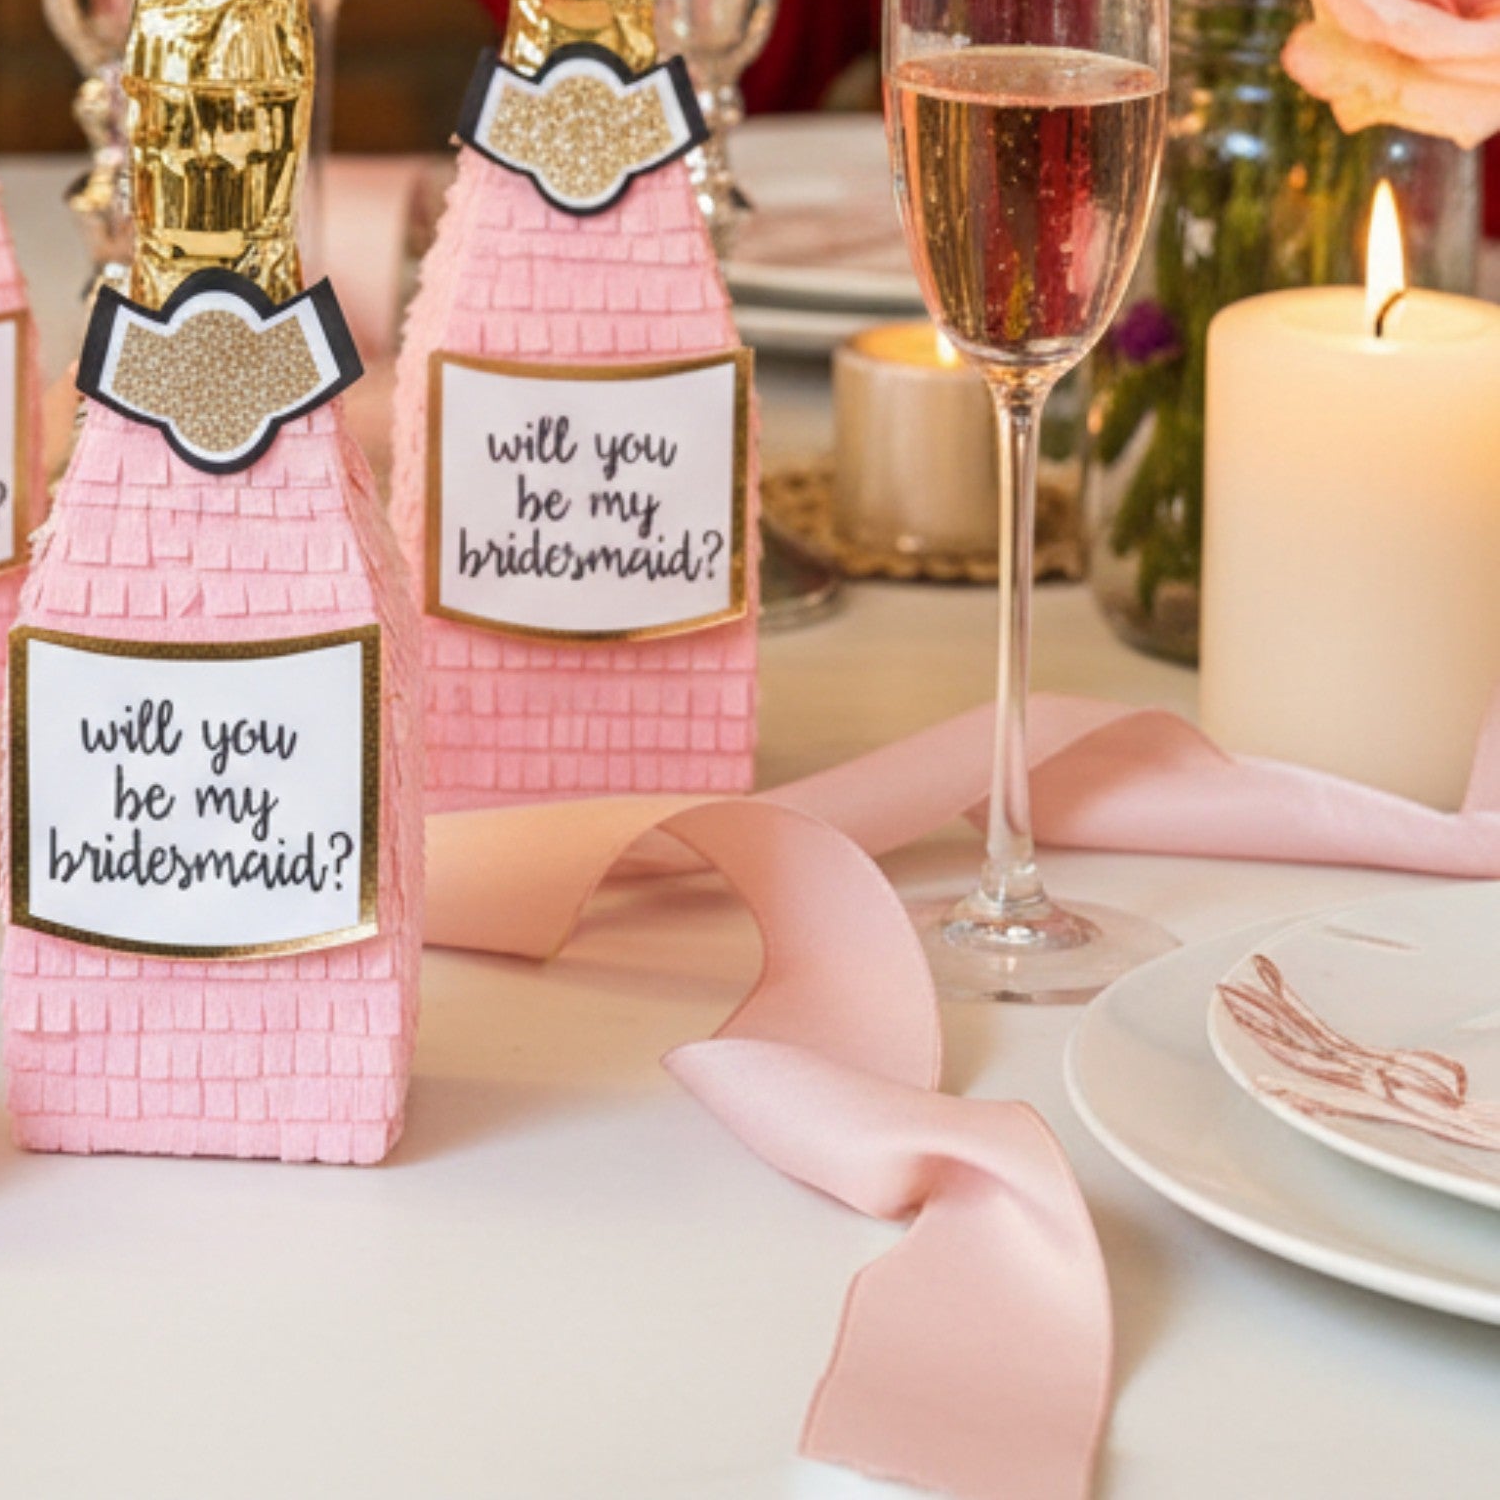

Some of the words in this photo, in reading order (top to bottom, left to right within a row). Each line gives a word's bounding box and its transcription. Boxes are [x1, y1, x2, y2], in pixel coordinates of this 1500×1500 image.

[487, 415, 578, 463] will
[594, 433, 678, 481] you
[517, 474, 571, 522] be
[589, 490, 661, 538] my
[458, 527, 724, 582] bridesmaid?
[81, 699, 182, 756] will
[201, 718, 297, 775] you
[114, 764, 176, 822] be
[195, 784, 279, 842] my
[49, 826, 354, 892] bridesmaid?
